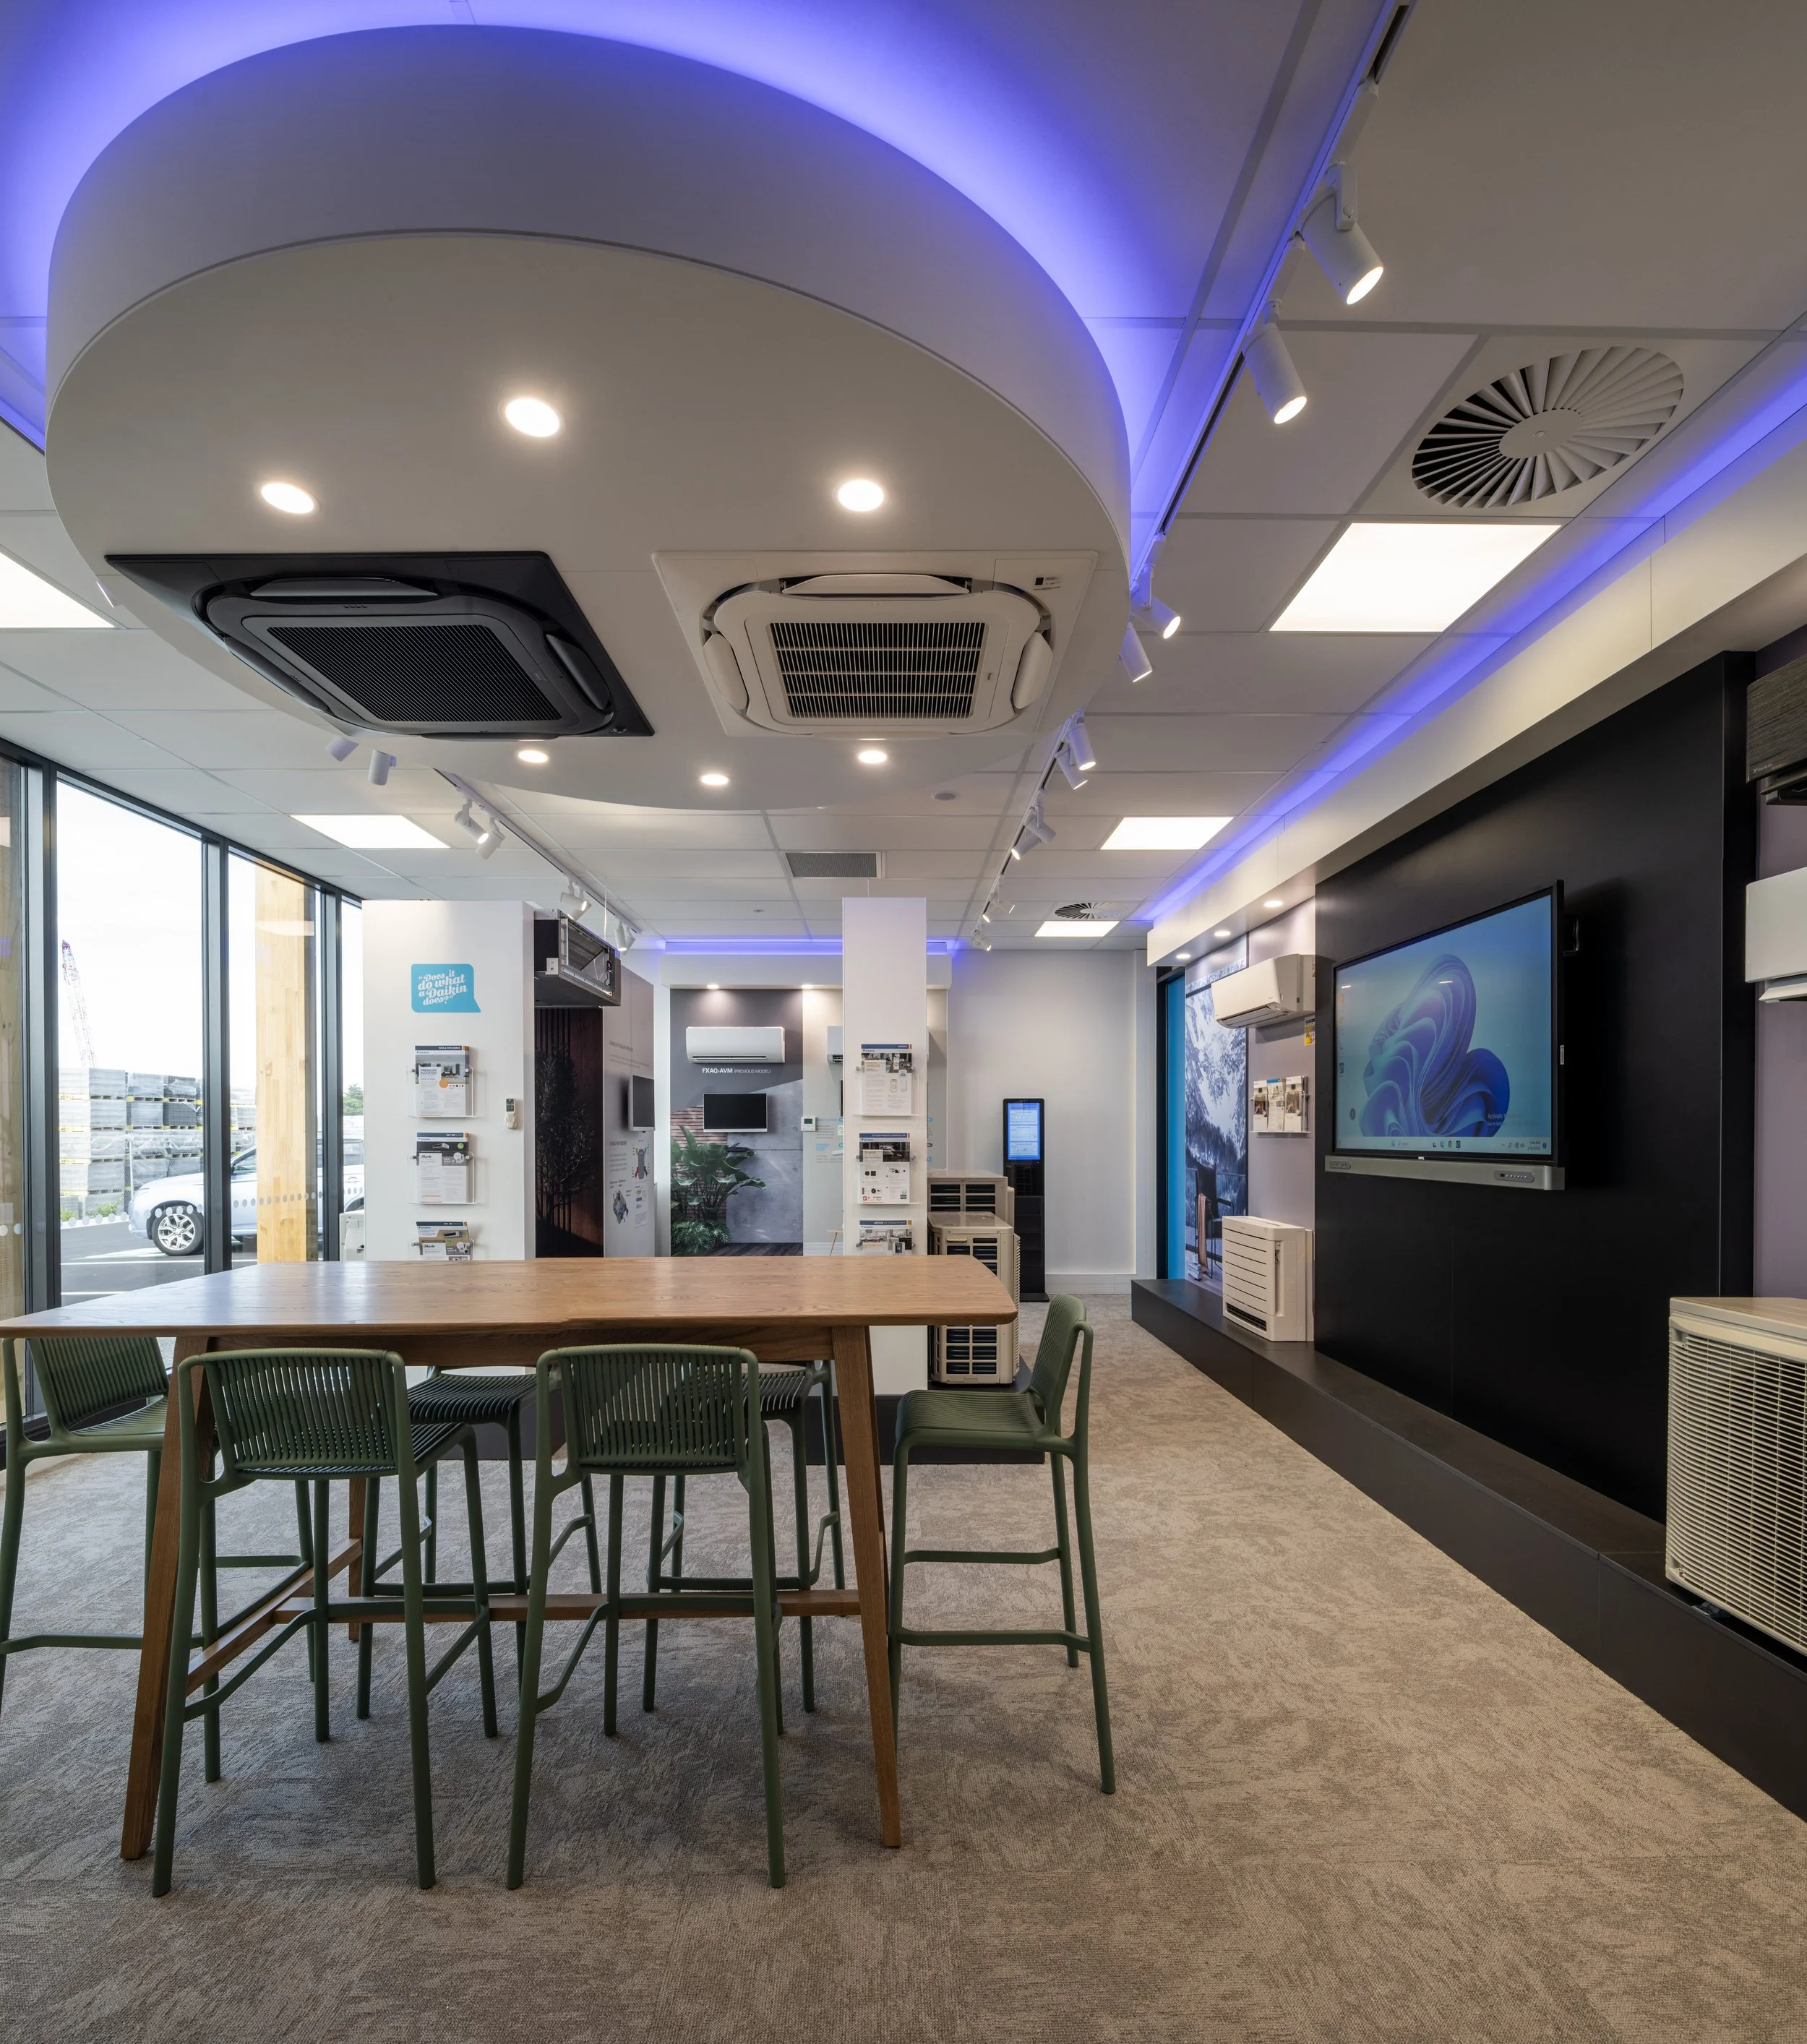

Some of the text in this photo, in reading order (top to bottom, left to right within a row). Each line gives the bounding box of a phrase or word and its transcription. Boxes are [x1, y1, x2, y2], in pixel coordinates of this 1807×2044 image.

[418, 974, 465, 990] do what
[426, 984, 468, 998] Daikin
